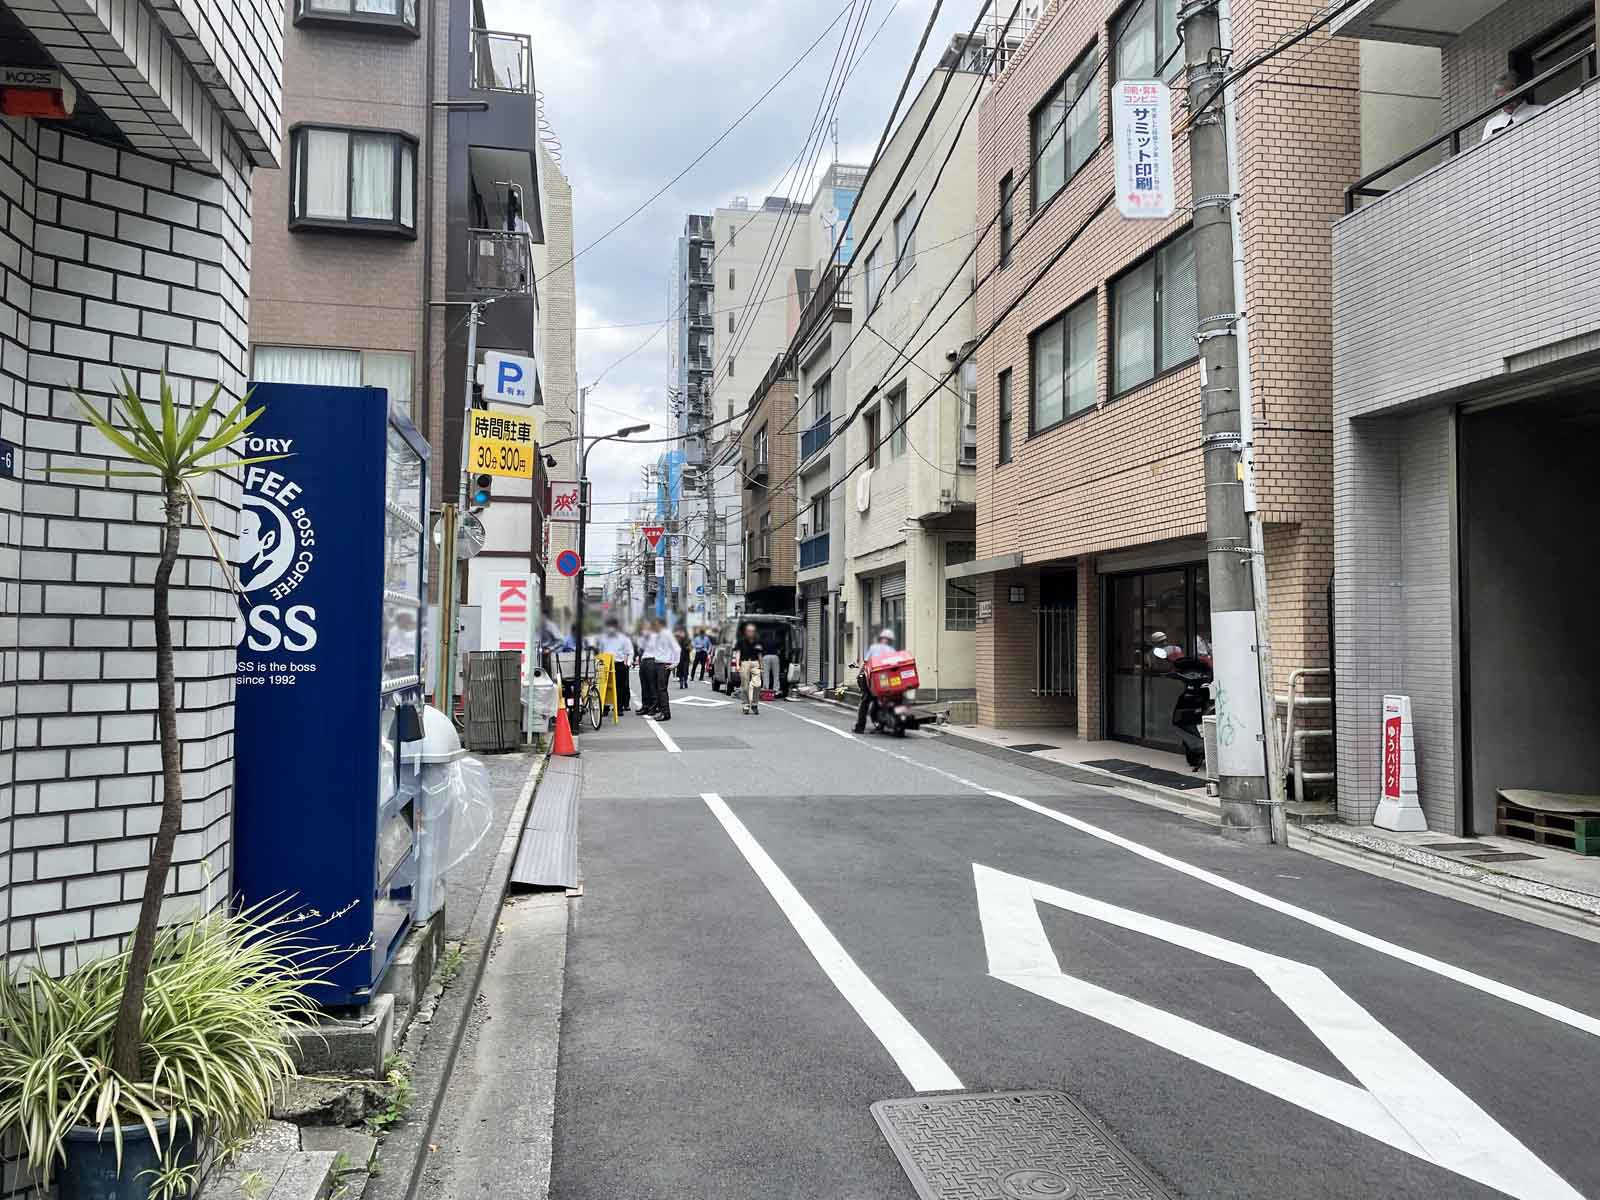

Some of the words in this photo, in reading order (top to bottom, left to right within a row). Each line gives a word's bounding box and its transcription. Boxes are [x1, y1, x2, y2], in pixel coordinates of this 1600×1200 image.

[1123, 95, 1160, 104] コンビニ
[1133, 107, 1153, 191] サミット印刷
[497, 360, 523, 394] P
[474, 416, 532, 443] 時間駐車
[243, 437, 294, 453] ORY
[477, 446, 497, 470] 30分
[499, 446, 527, 473] 300円
[291, 507, 315, 547] BOSS
[269, 551, 313, 601] COFFEE
[236, 662, 254, 672] SS
[257, 662, 267, 672] is
[269, 662, 287, 672] the
[290, 662, 317, 672] boss
[236, 675, 265, 685] since
[269, 675, 296, 685] 1992
[1387, 725, 1396, 788] ゆうパック
